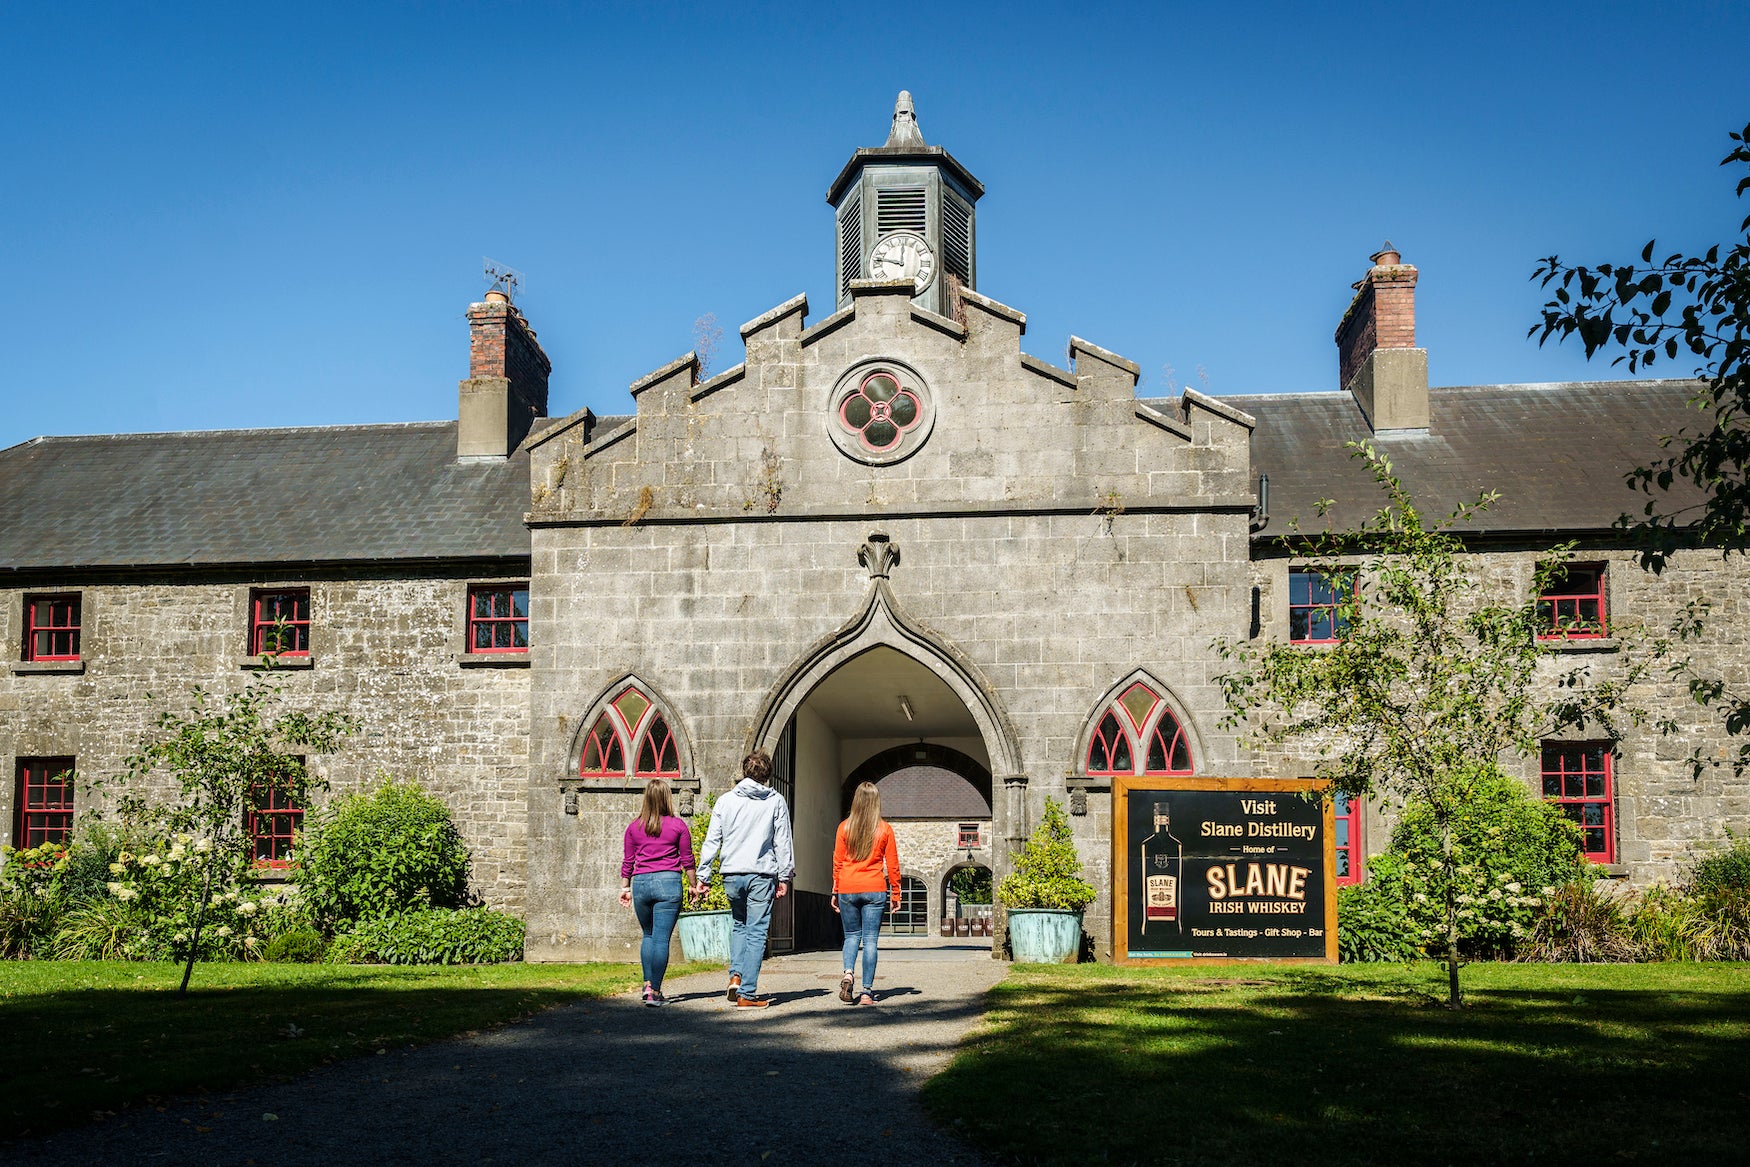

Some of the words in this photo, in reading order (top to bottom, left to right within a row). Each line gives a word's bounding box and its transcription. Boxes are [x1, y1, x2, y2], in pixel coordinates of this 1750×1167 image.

[1241, 799, 1277, 815] Visit
[1201, 821, 1243, 837] Slane
[1247, 821, 1317, 841] Distillery
[1242, 845, 1265, 853] Home
[1266, 845, 1275, 853] of
[1150, 879, 1173, 887] SLANE
[1205, 862, 1308, 900] SLANE
[1209, 901, 1244, 914] IRISH
[1247, 901, 1307, 914] WHISKEY
[1191, 928, 1214, 937] Tours
[1216, 928, 1223, 937] &
[1224, 928, 1258, 938] Tastings
[1264, 928, 1280, 937] Gift
[1281, 928, 1302, 938] Shop
[1309, 928, 1323, 937] Bar
